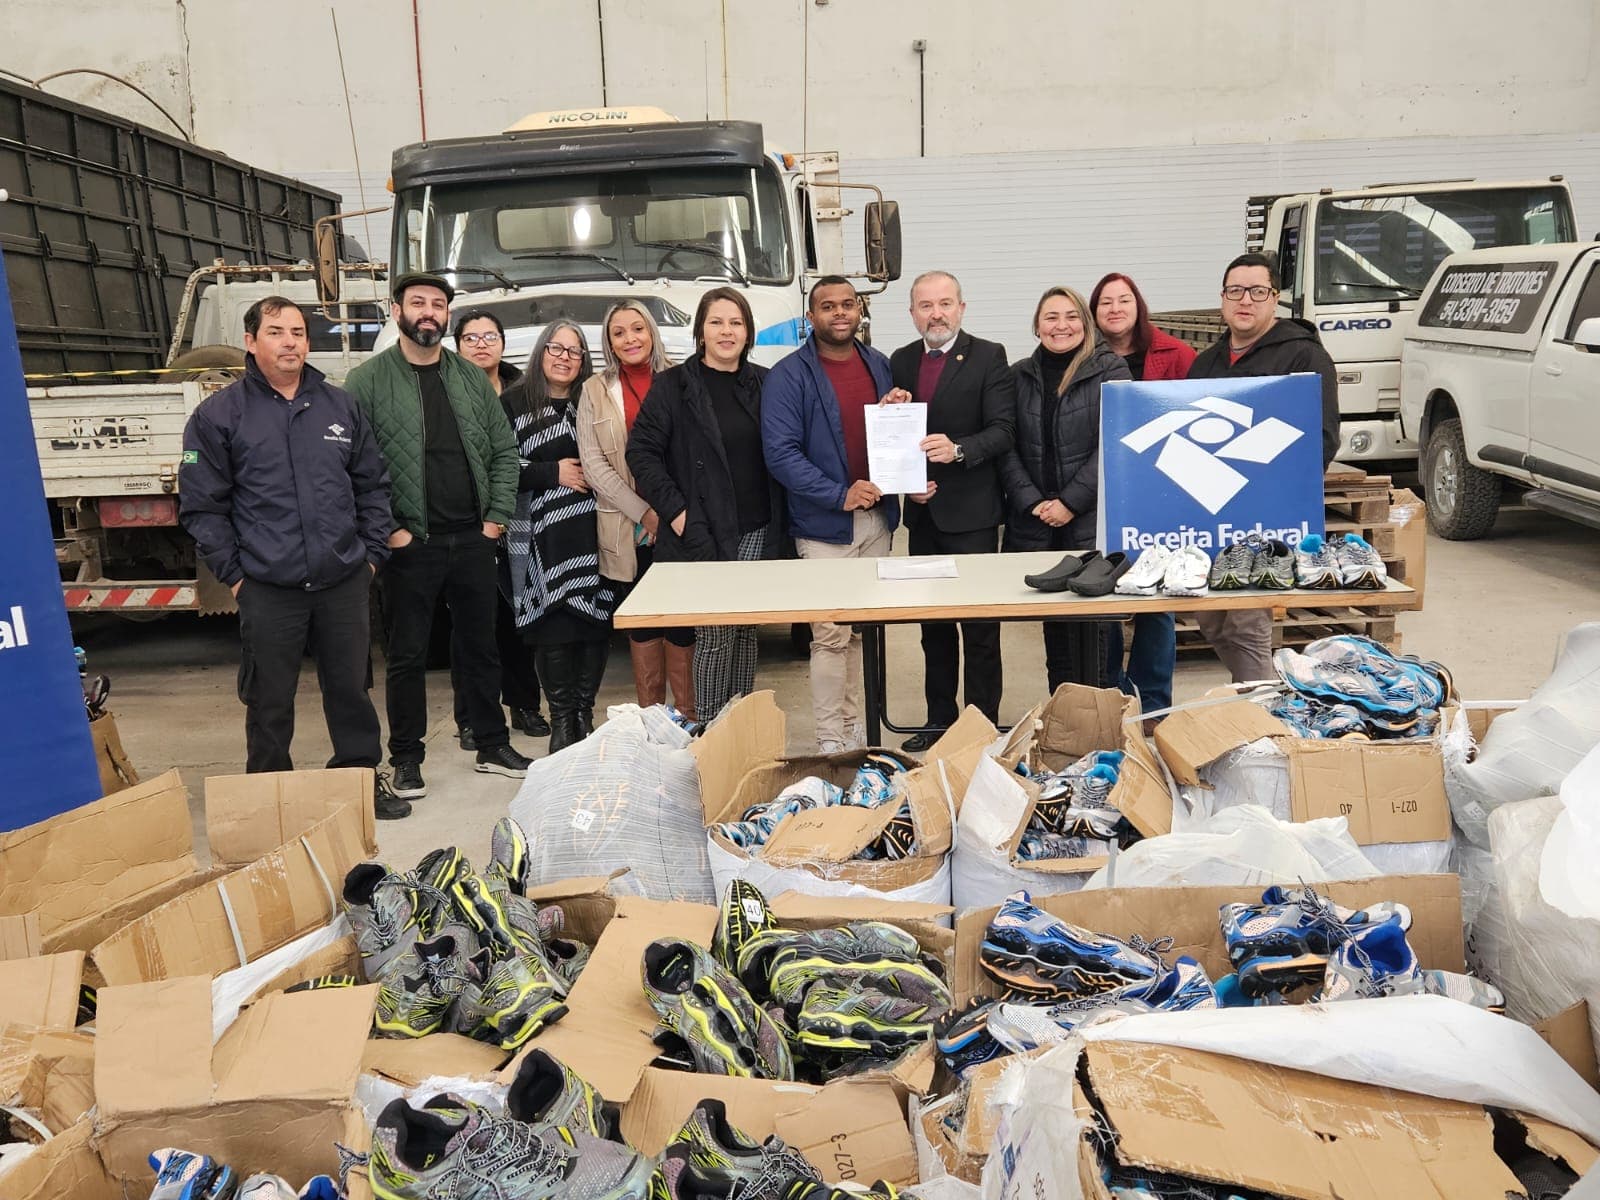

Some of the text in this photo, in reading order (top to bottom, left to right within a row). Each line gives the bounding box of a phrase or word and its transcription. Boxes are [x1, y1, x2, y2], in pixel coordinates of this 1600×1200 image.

[548, 111, 628, 124] NICOLINI
[1440, 271, 1548, 295] CONSERTO DE TRATORES
[1319, 318, 1392, 332] CARGO
[1121, 521, 1309, 550] Receita Federal
[1339, 803, 1353, 816] 40
[1391, 800, 1418, 814] 027-1
[830, 1133, 857, 1180] 027-3
